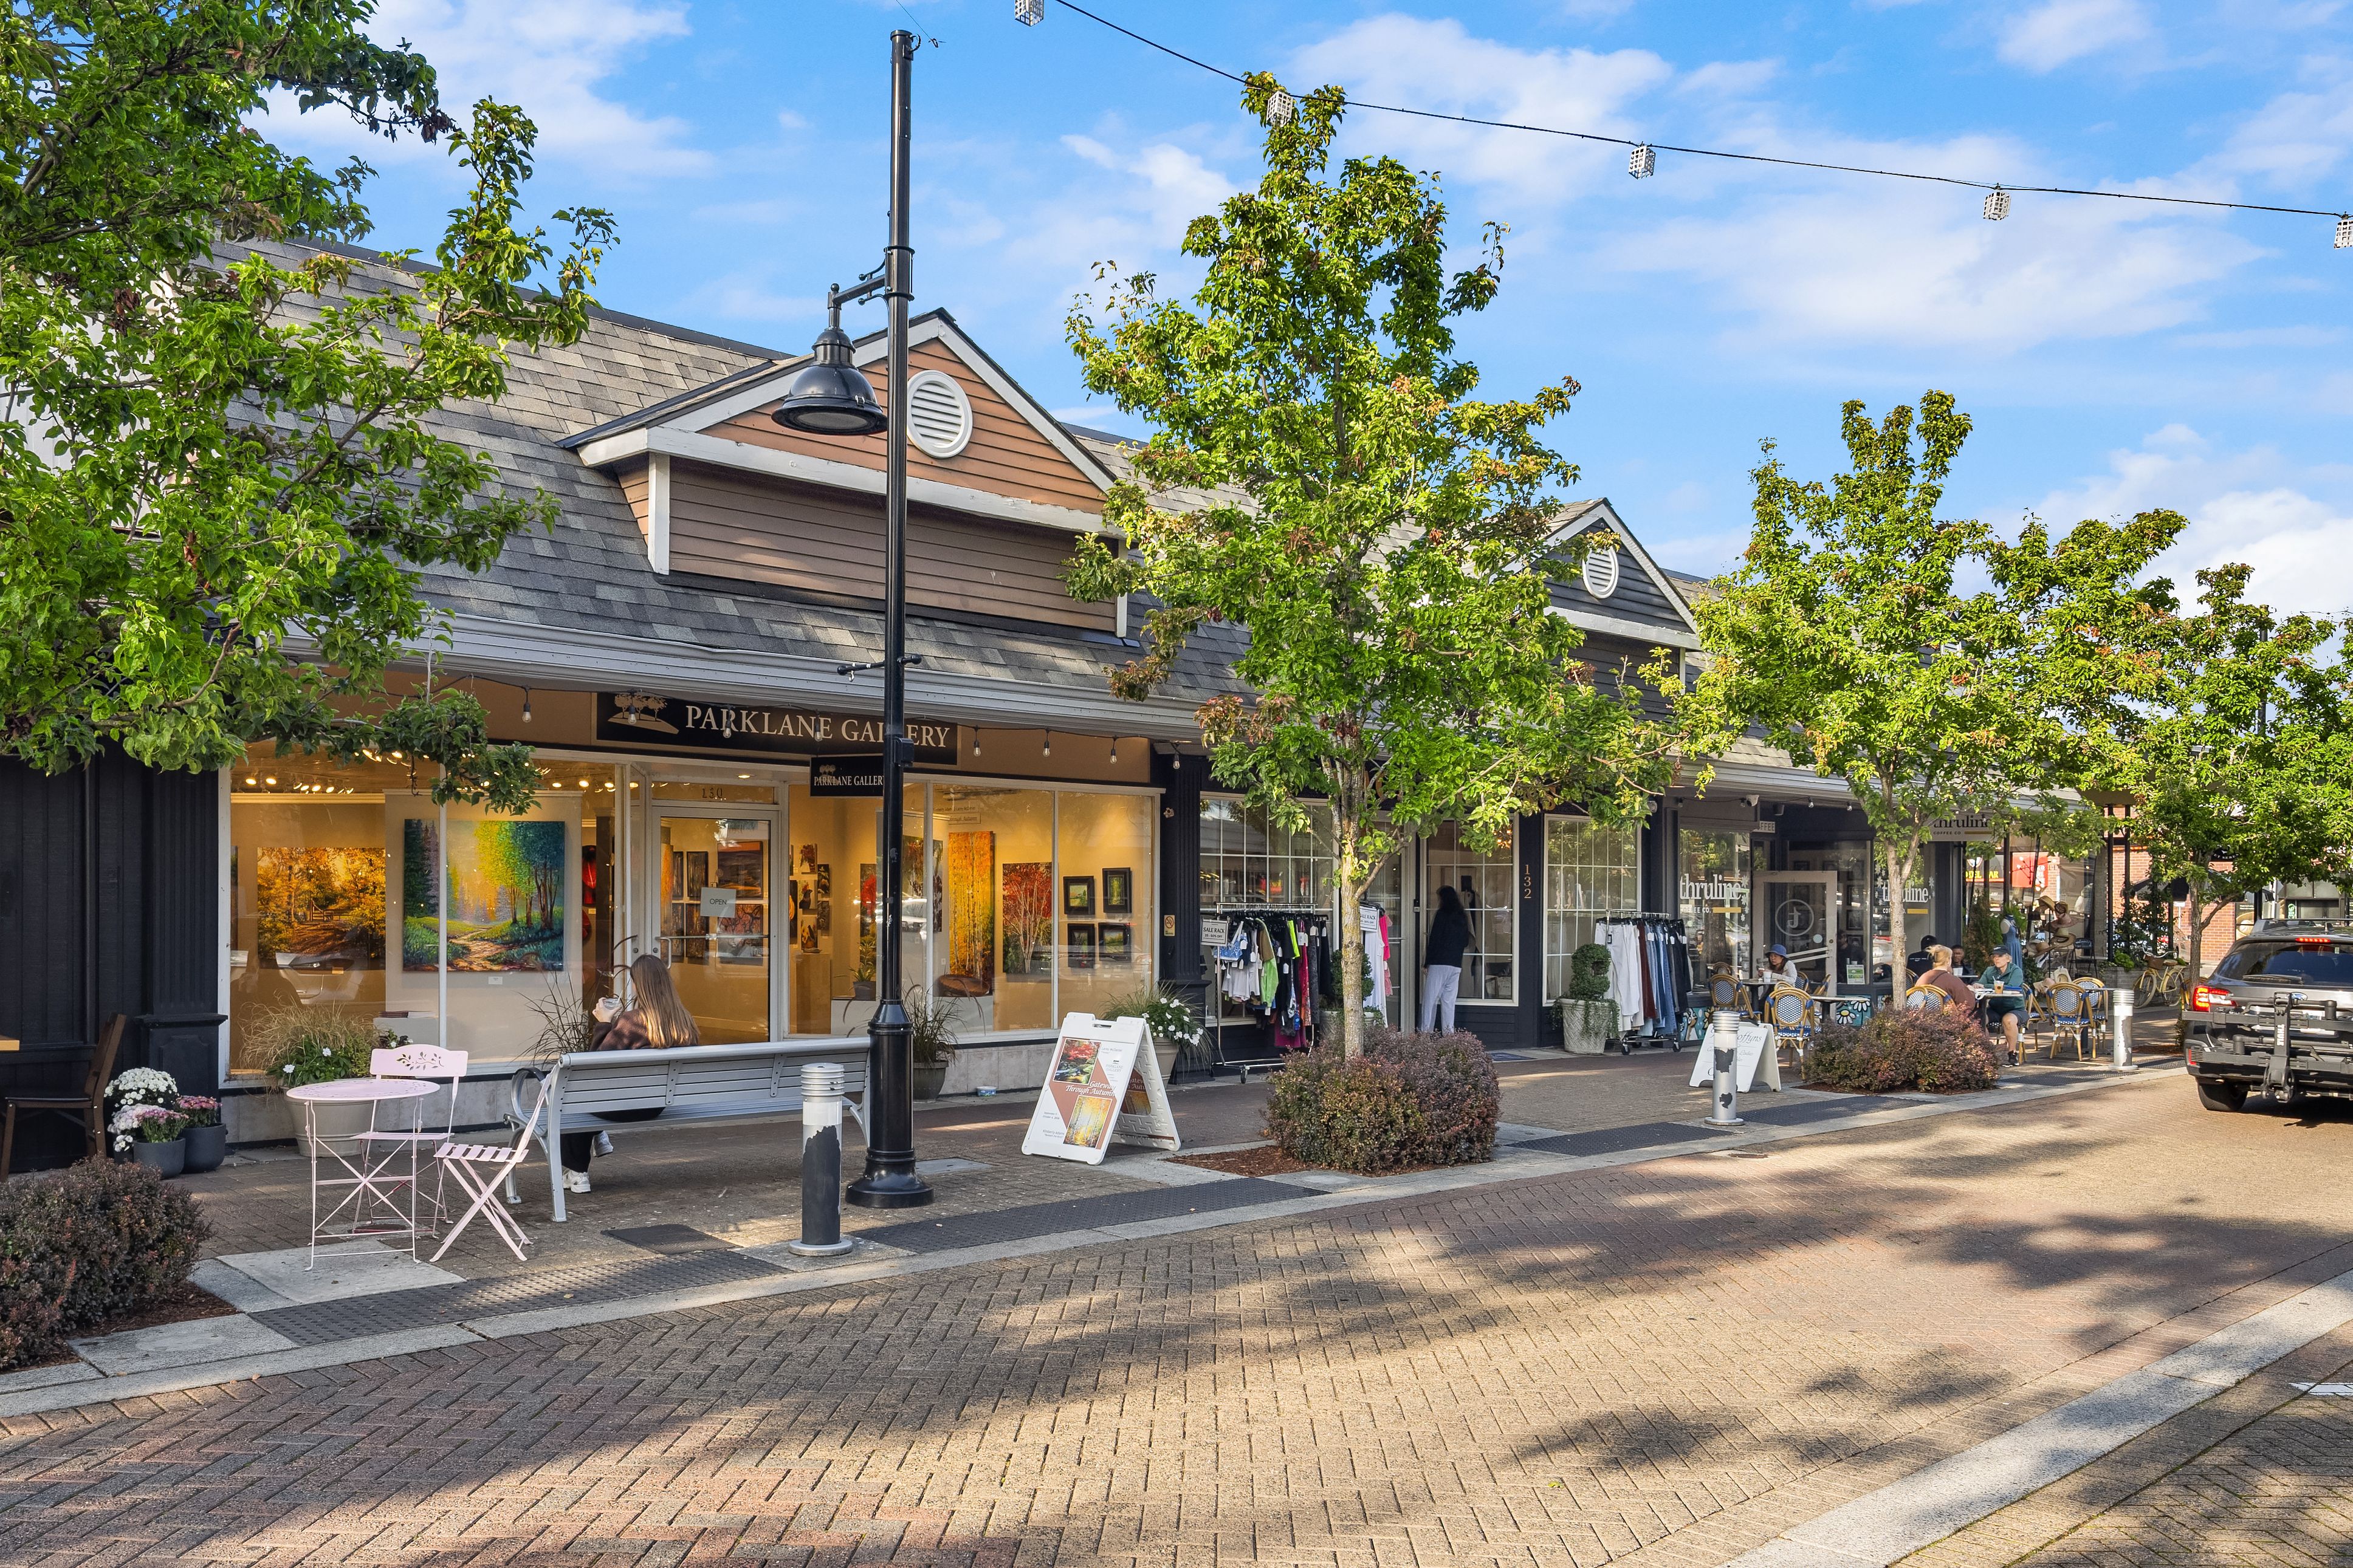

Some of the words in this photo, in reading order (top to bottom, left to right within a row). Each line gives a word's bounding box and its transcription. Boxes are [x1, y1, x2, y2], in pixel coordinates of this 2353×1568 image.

[685, 705, 833, 739] PARKLANE
[814, 776, 852, 786] PARKLANE
[854, 775, 884, 786] GALLER
[1760, 822, 1775, 830] FFEE
[1680, 873, 1742, 900] thruline
[2276, 1024, 2285, 1046] THULE
[1065, 1085, 1089, 1095] Through
